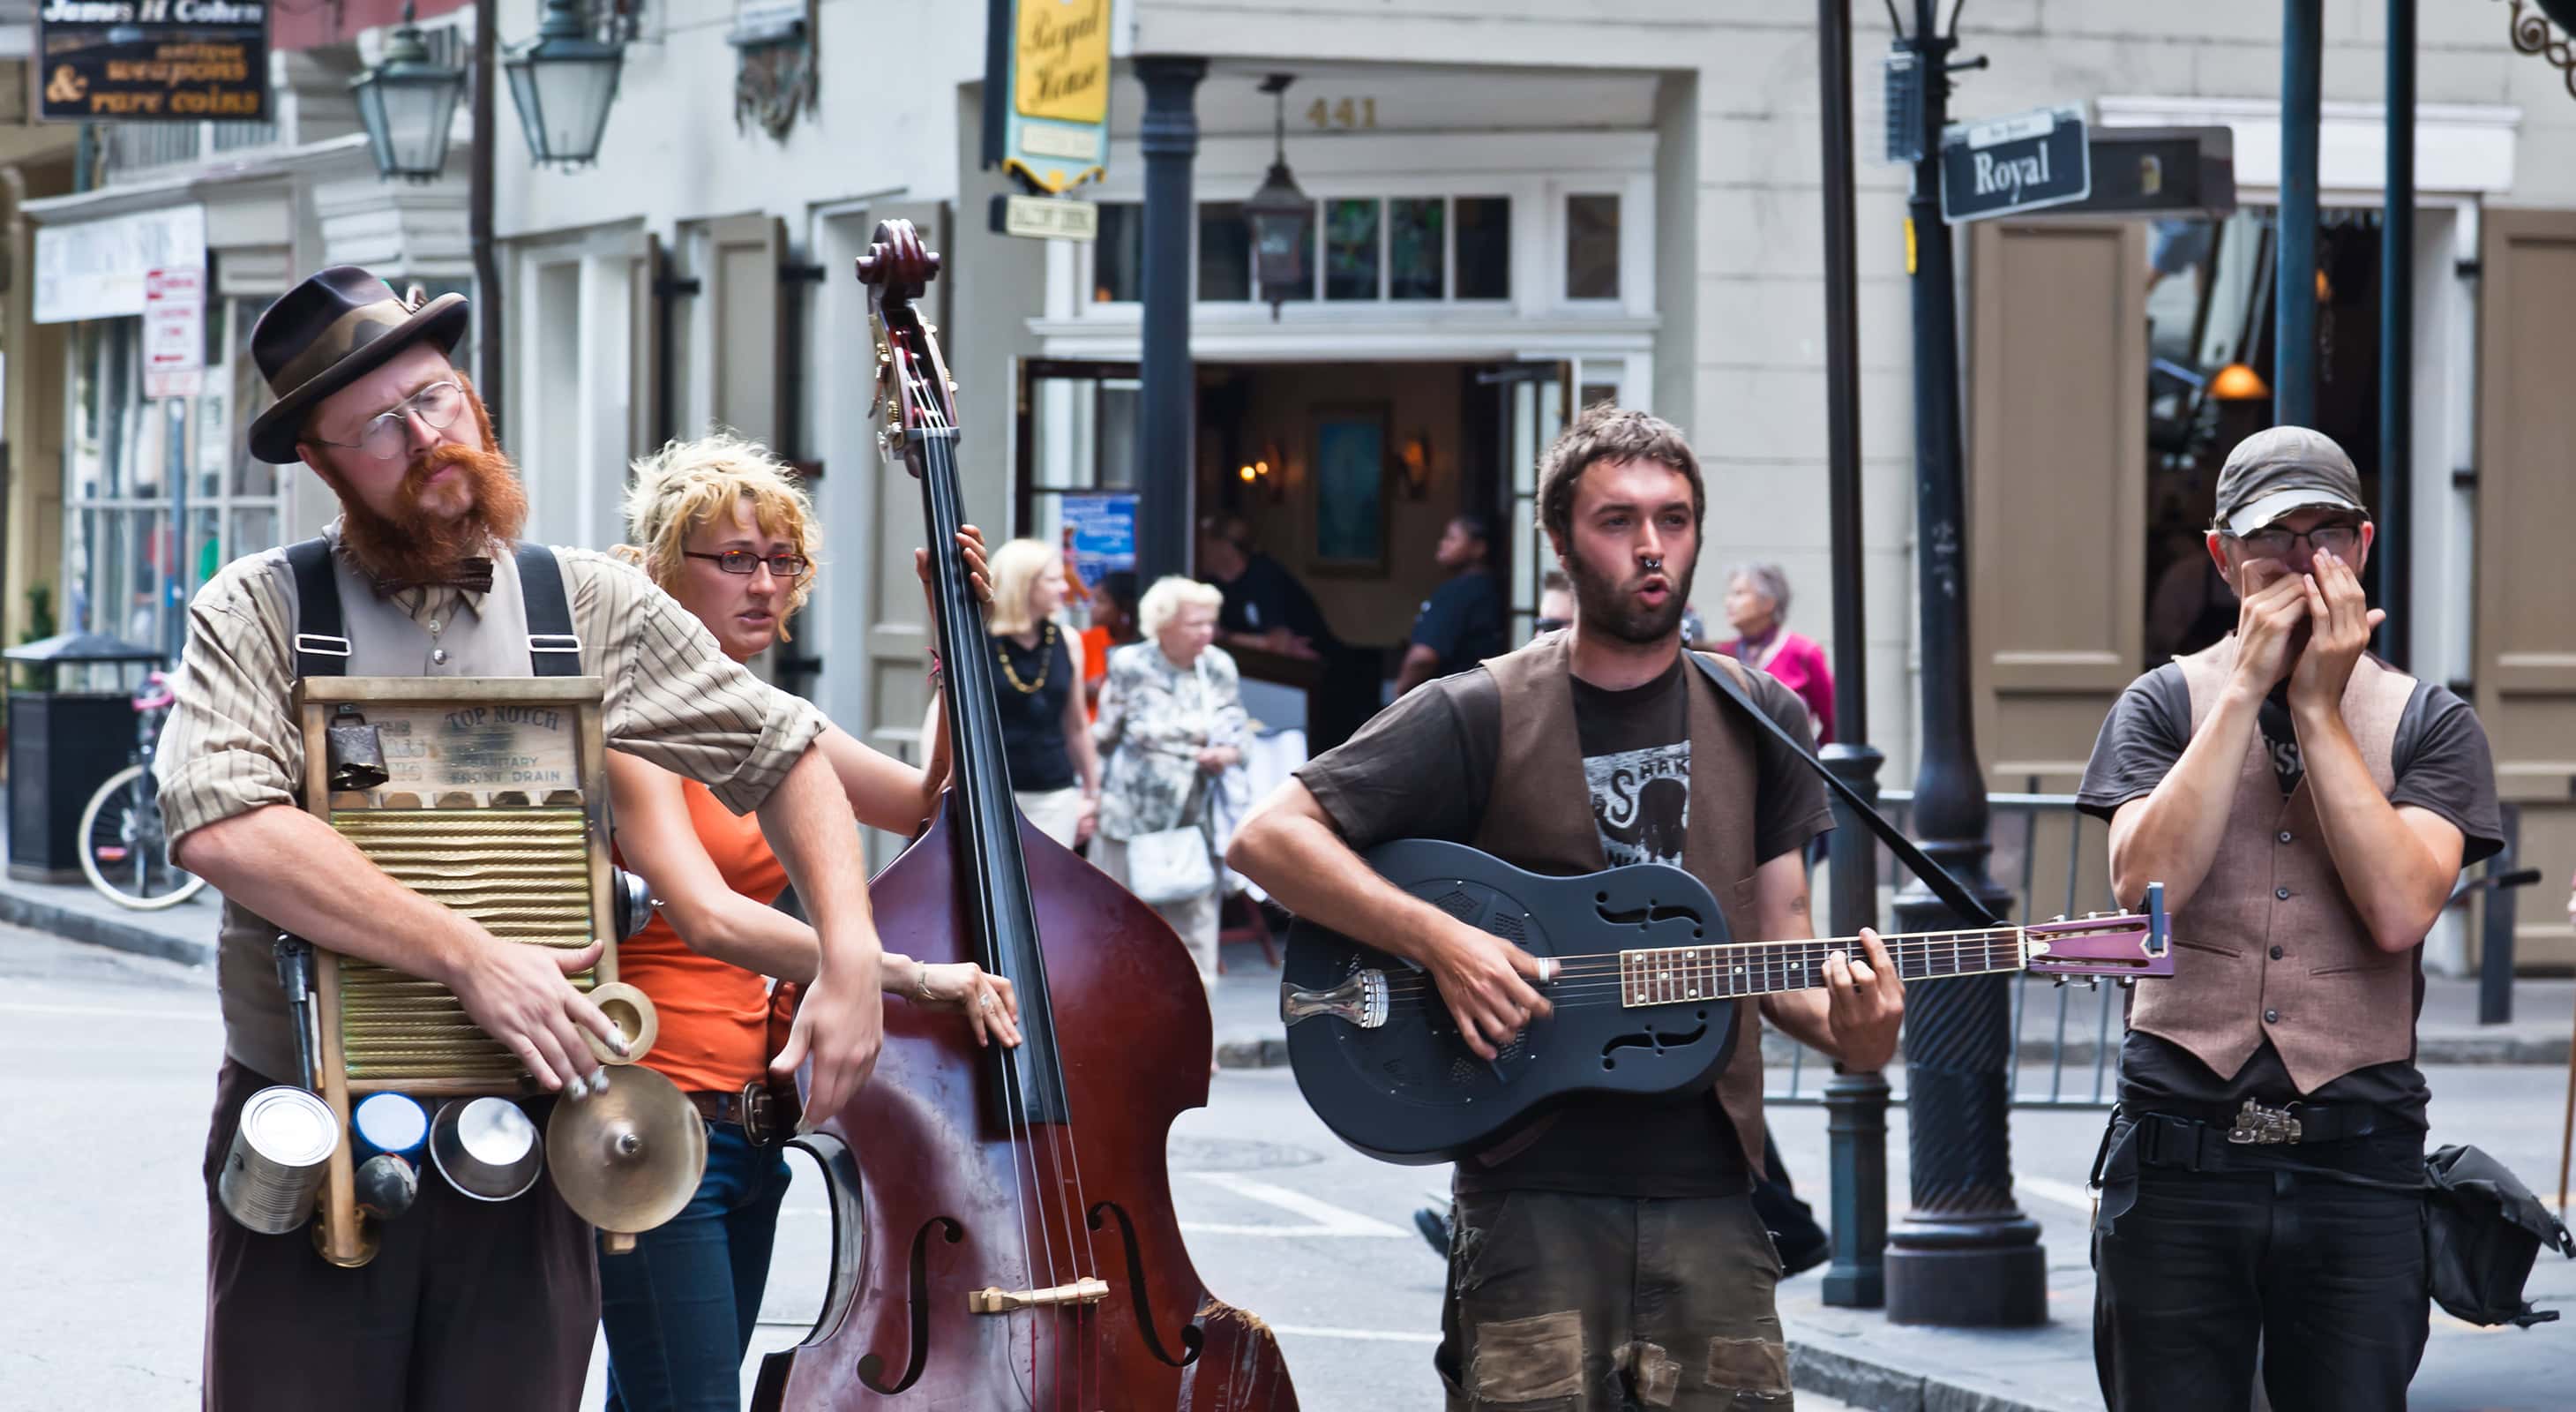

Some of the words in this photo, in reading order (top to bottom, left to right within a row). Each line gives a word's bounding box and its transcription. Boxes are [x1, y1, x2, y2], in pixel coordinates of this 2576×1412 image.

[1307, 98, 1377, 128] 441
[1973, 139, 2051, 206] Royal
[445, 707, 486, 731] TOP
[494, 705, 559, 731] NOTCH
[512, 770, 560, 783] DRAIN
